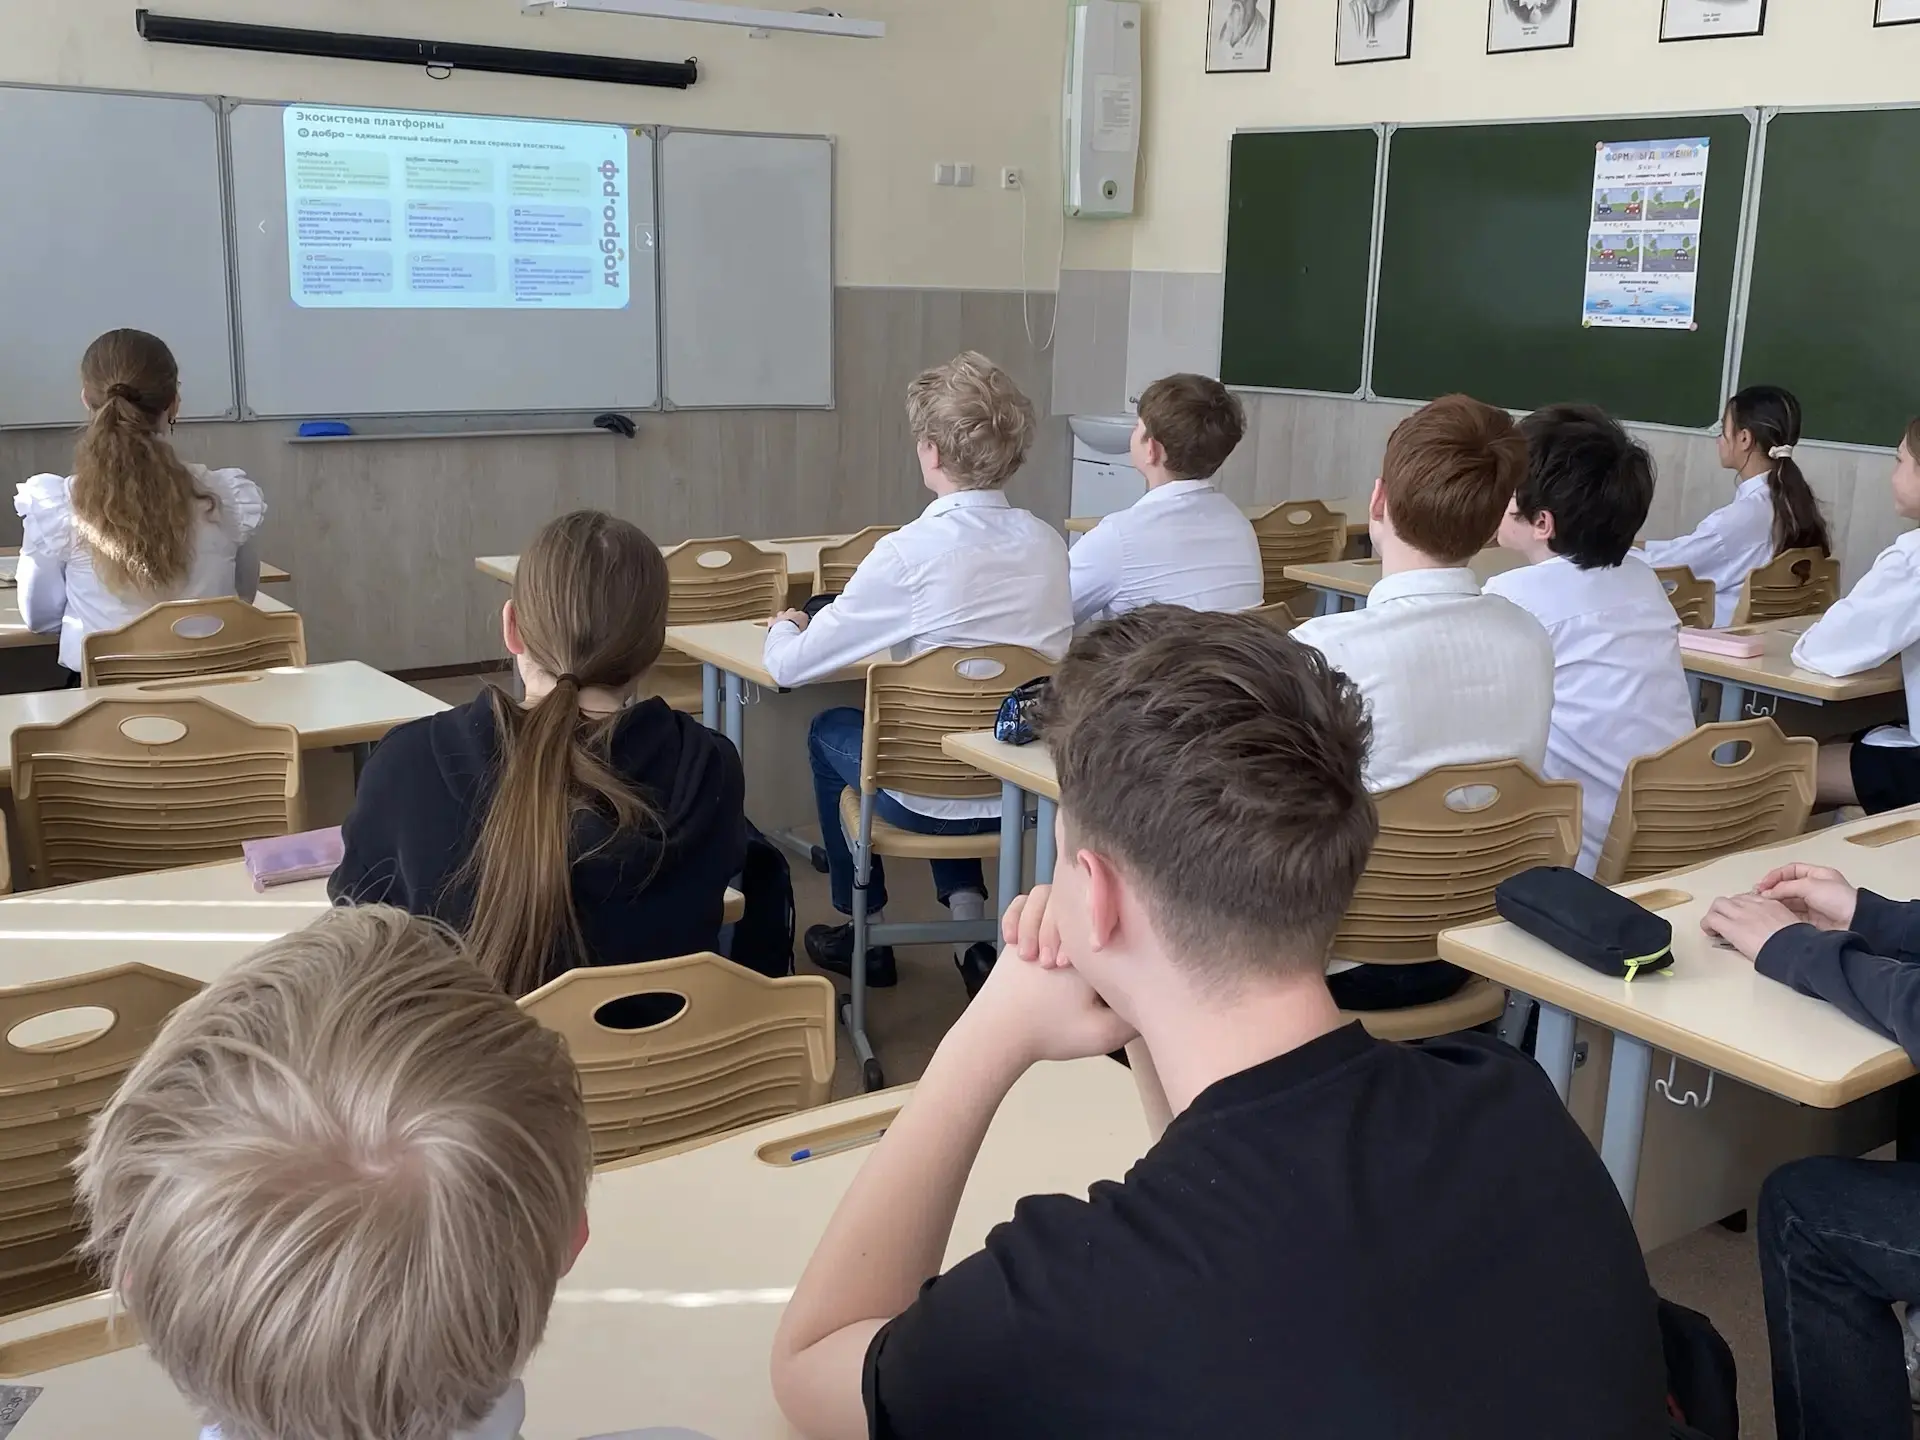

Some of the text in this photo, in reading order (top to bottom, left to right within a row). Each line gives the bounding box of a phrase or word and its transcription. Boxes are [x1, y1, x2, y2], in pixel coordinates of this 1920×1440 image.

[296, 111, 444, 130] Экосистема платформы
[311, 129, 345, 140] добро
[598, 160, 621, 288] добро.рф
